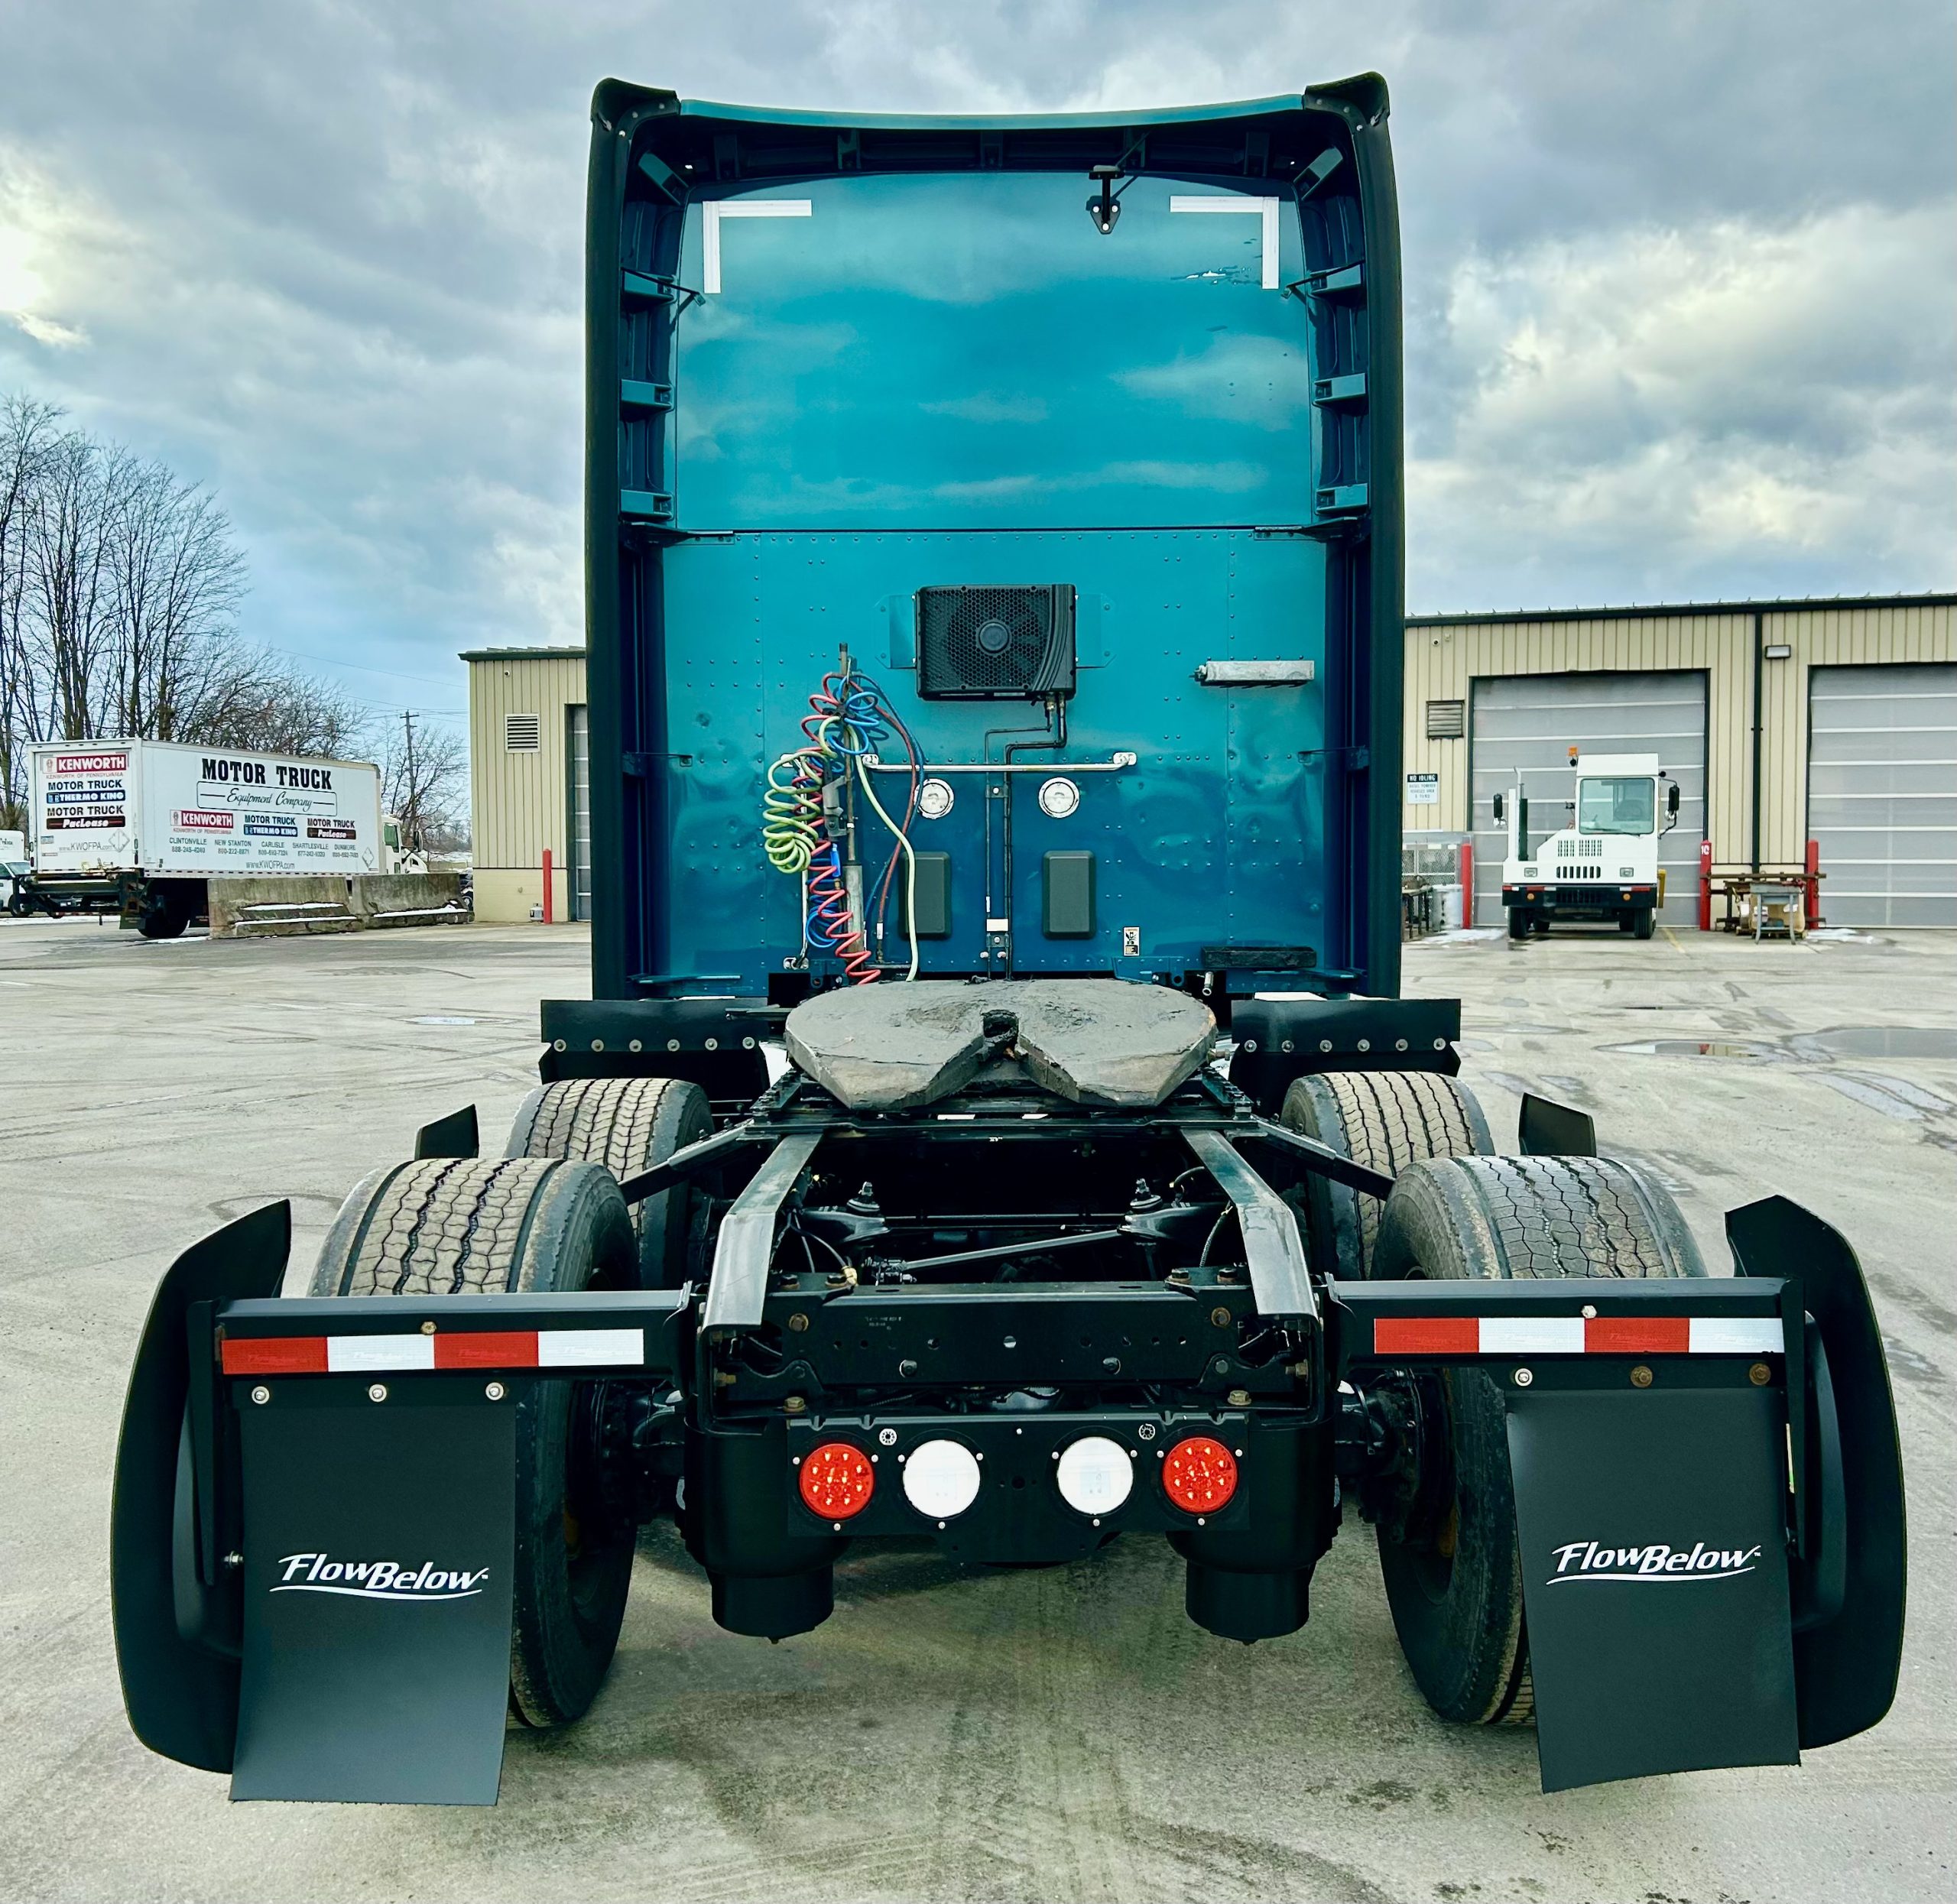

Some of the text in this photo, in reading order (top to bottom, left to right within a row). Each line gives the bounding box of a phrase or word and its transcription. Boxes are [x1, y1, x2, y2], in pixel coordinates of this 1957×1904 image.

[58, 757, 125, 770] KENWORTH
[202, 758, 332, 790] MOTOR TRUCK
[48, 779, 122, 790] MOTOR TRUCK
[60, 792, 124, 802] THERMO KING
[226, 788, 313, 812] Equipment Company
[47, 805, 124, 816] MOTOR TRUCK
[62, 818, 109, 828] PacLease
[183, 813, 232, 826] KENWORTH
[245, 815, 296, 825] MOTOR TRUCK
[307, 818, 355, 829] MOTOR TRUCK
[317, 829, 347, 838] PacLease
[59, 842, 112, 851] www.KWOFPA.com
[169, 837, 207, 845] CLINTONVILLE
[1552, 1541, 1761, 1574] FlowBelow
[278, 1553, 489, 1590] FlowBelow
